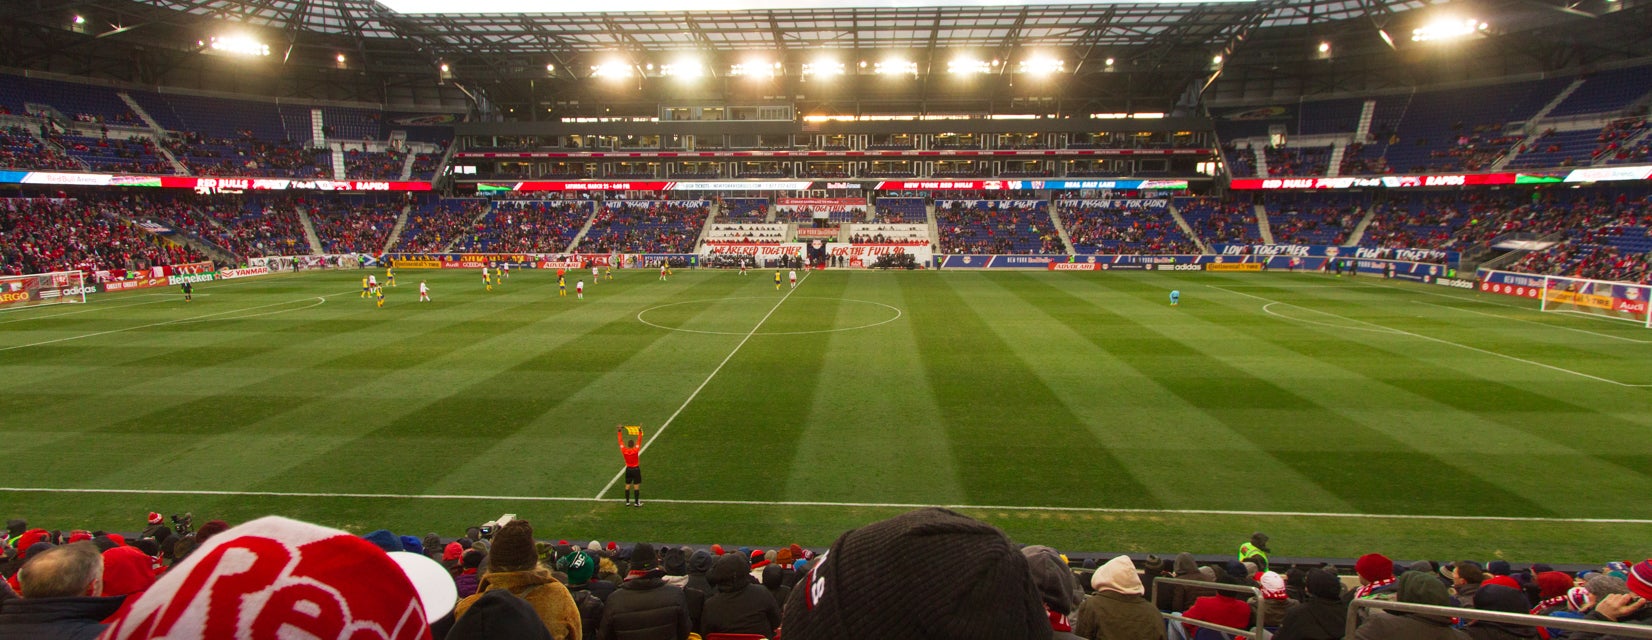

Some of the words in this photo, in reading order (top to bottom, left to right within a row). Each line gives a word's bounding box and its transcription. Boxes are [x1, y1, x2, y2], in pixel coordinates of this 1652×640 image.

[196, 178, 218, 188] RED
[219, 179, 249, 190] BULLS
[1007, 181, 1022, 190] VS
[1262, 179, 1283, 189] RED
[1283, 179, 1313, 188] BULLS
[1425, 175, 1465, 186] RAPIDS
[355, 182, 389, 191] RAPIDS
[830, 246, 848, 256] FOR
[850, 246, 865, 256] THE
[867, 246, 891, 256] FULL
[1253, 244, 1310, 257] TOGETHER
[235, 267, 268, 276] YANMAR
[1174, 263, 1201, 271] adidas
[168, 272, 213, 286] Heineken
[1449, 279, 1474, 289] adidas
[62, 285, 97, 296] adidas
[1619, 301, 1645, 312] Audi
